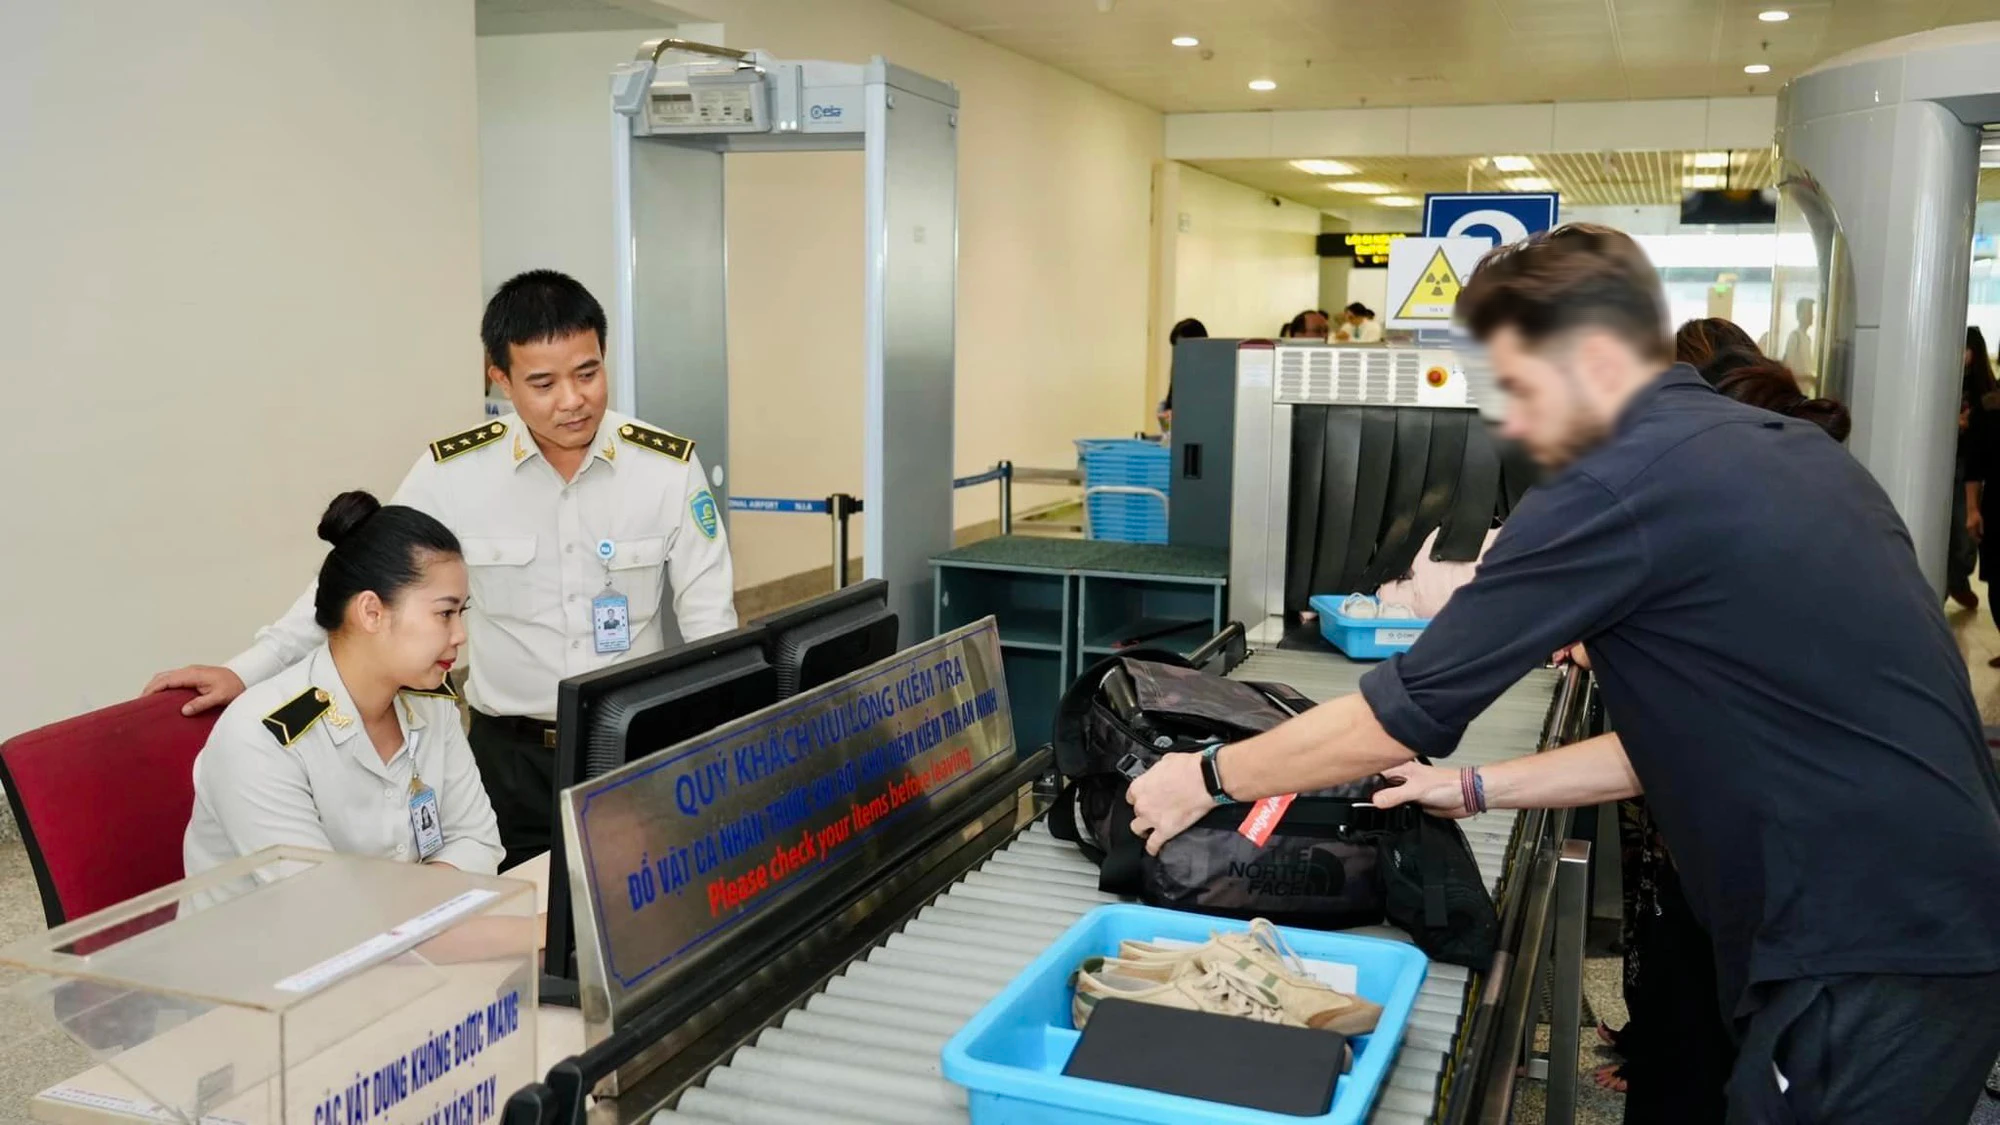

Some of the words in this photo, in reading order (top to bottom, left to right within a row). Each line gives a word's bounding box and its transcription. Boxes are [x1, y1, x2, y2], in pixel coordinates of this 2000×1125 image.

[895, 662, 936, 711] KIỂM
[936, 655, 965, 692] TRA
[915, 708, 943, 753] KIỂM
[942, 705, 962, 739] TRA
[961, 698, 976, 728] AN
[975, 687, 998, 720] NINH
[707, 864, 768, 917] Please
[769, 830, 816, 880] check
[817, 815, 850, 861] your
[851, 793, 889, 831] items
[888, 772, 932, 806] before
[931, 747, 970, 781] leaving
[1229, 861, 1306, 880] NORTH
[1248, 882, 1303, 896] FACE
[373, 1055, 407, 1120] DỤNG
[411, 1029, 451, 1094] KHÔNG
[454, 1009, 484, 1067] ĐƯỢC
[487, 991, 519, 1047] MANG
[477, 1074, 497, 1123] TAY
